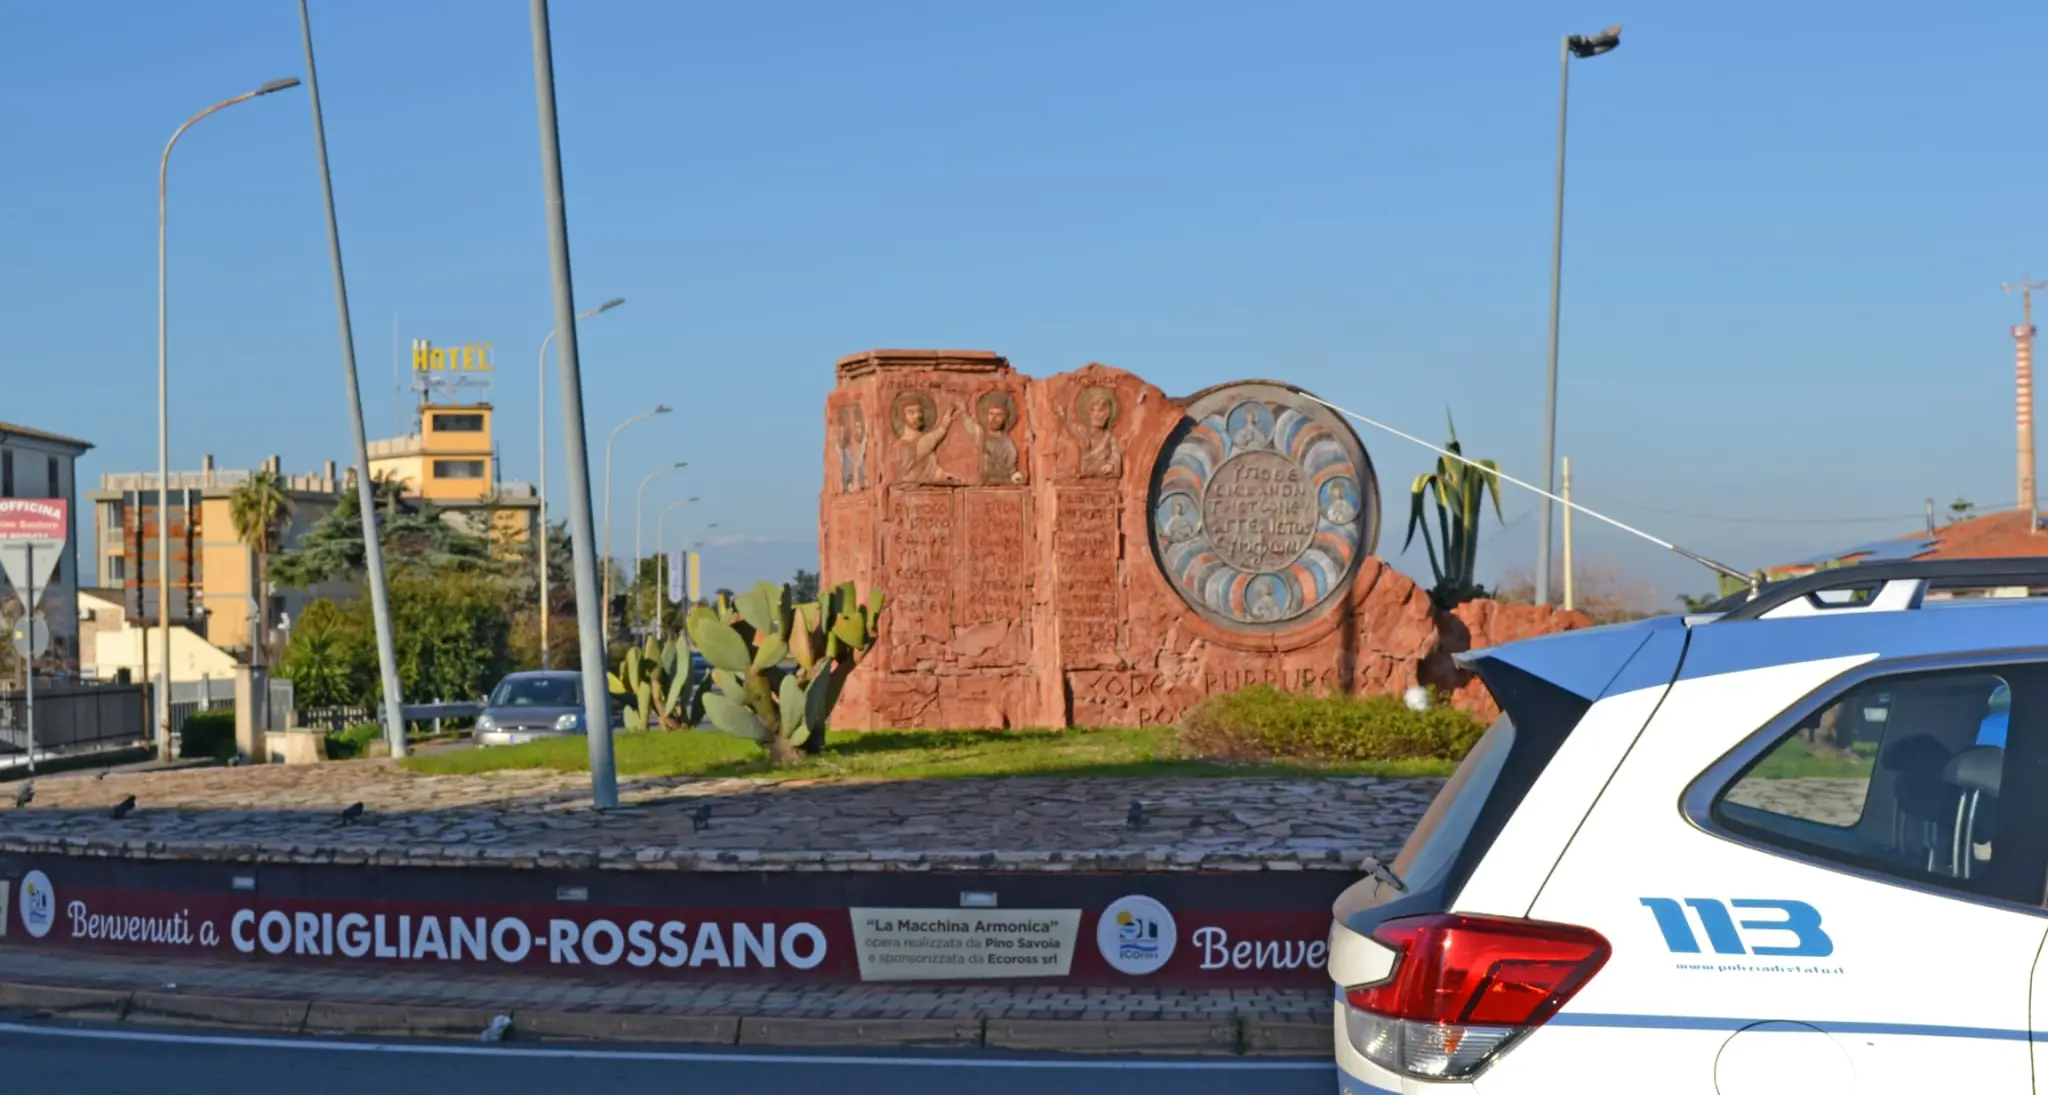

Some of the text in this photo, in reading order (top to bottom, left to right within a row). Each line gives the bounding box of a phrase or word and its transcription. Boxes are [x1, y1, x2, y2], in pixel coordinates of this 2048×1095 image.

[413, 347, 493, 371] HOTEL
[68, 900, 827, 970] Benvenuti a CORIGLIANO-ROSSANO
[898, 919, 969, 932] Macchina
[1638, 897, 1834, 957] 113
[864, 937, 1061, 950] opera realizzata da Pino Savoia
[1192, 926, 1326, 969] Benve
[868, 952, 1057, 965] e sponsorizzata da Ecoross srl
